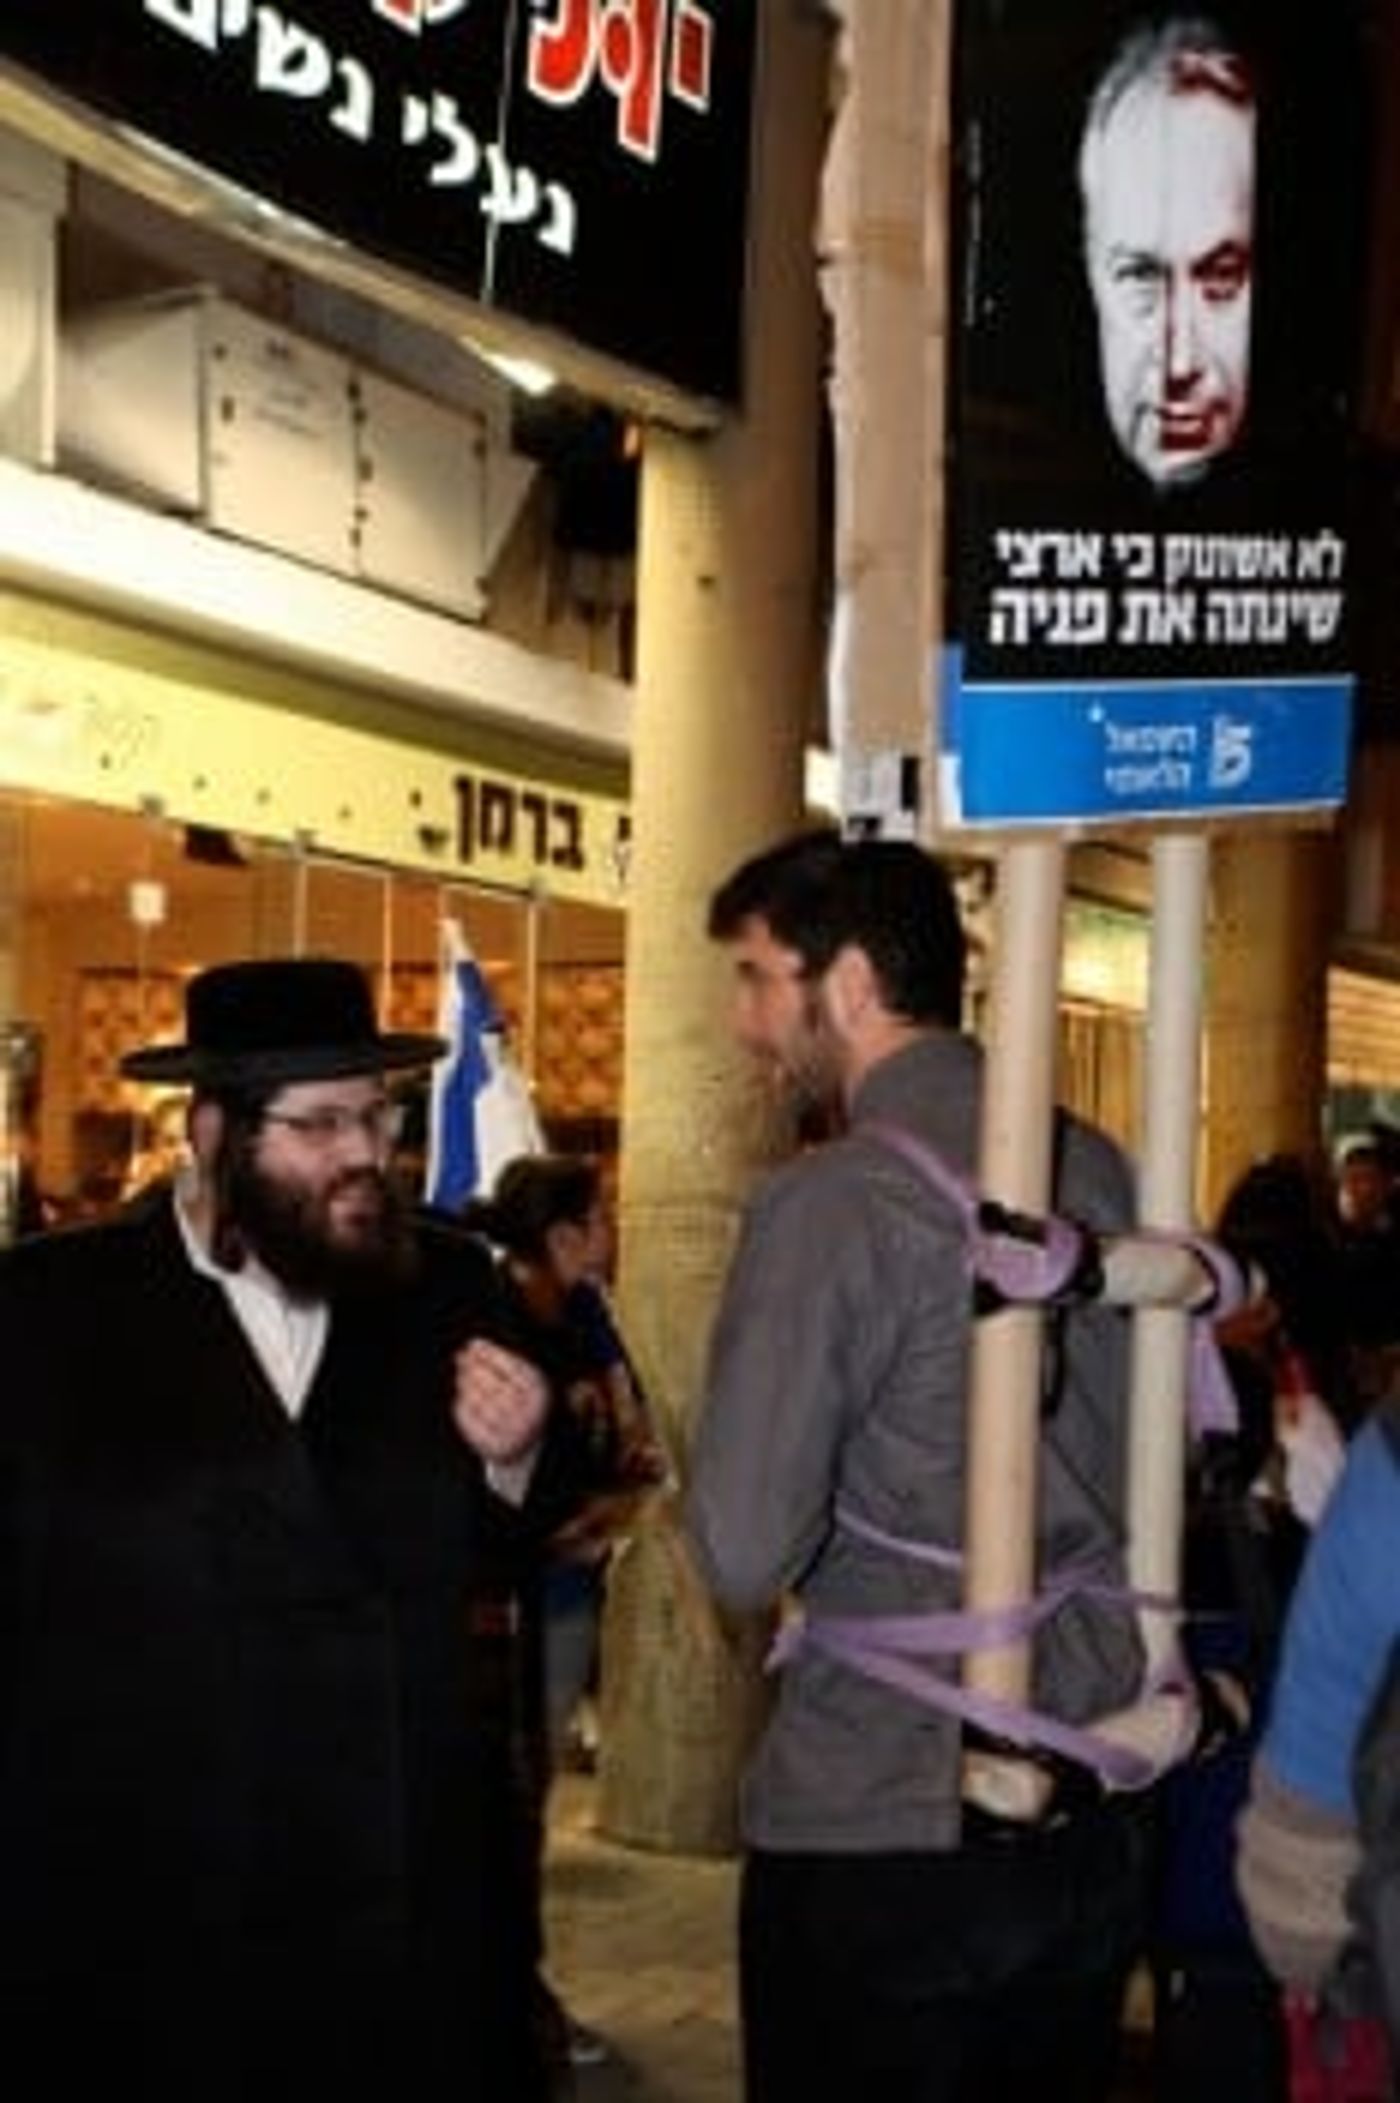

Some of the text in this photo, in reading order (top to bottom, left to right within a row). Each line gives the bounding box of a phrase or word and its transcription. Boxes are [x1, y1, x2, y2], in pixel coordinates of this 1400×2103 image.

[401, 89, 577, 256] נעלי
[996, 527, 1346, 588] לא אשתוק כי ארצי
[990, 589, 1343, 645] שינתה את פניה
[454, 772, 585, 873] ברמן
